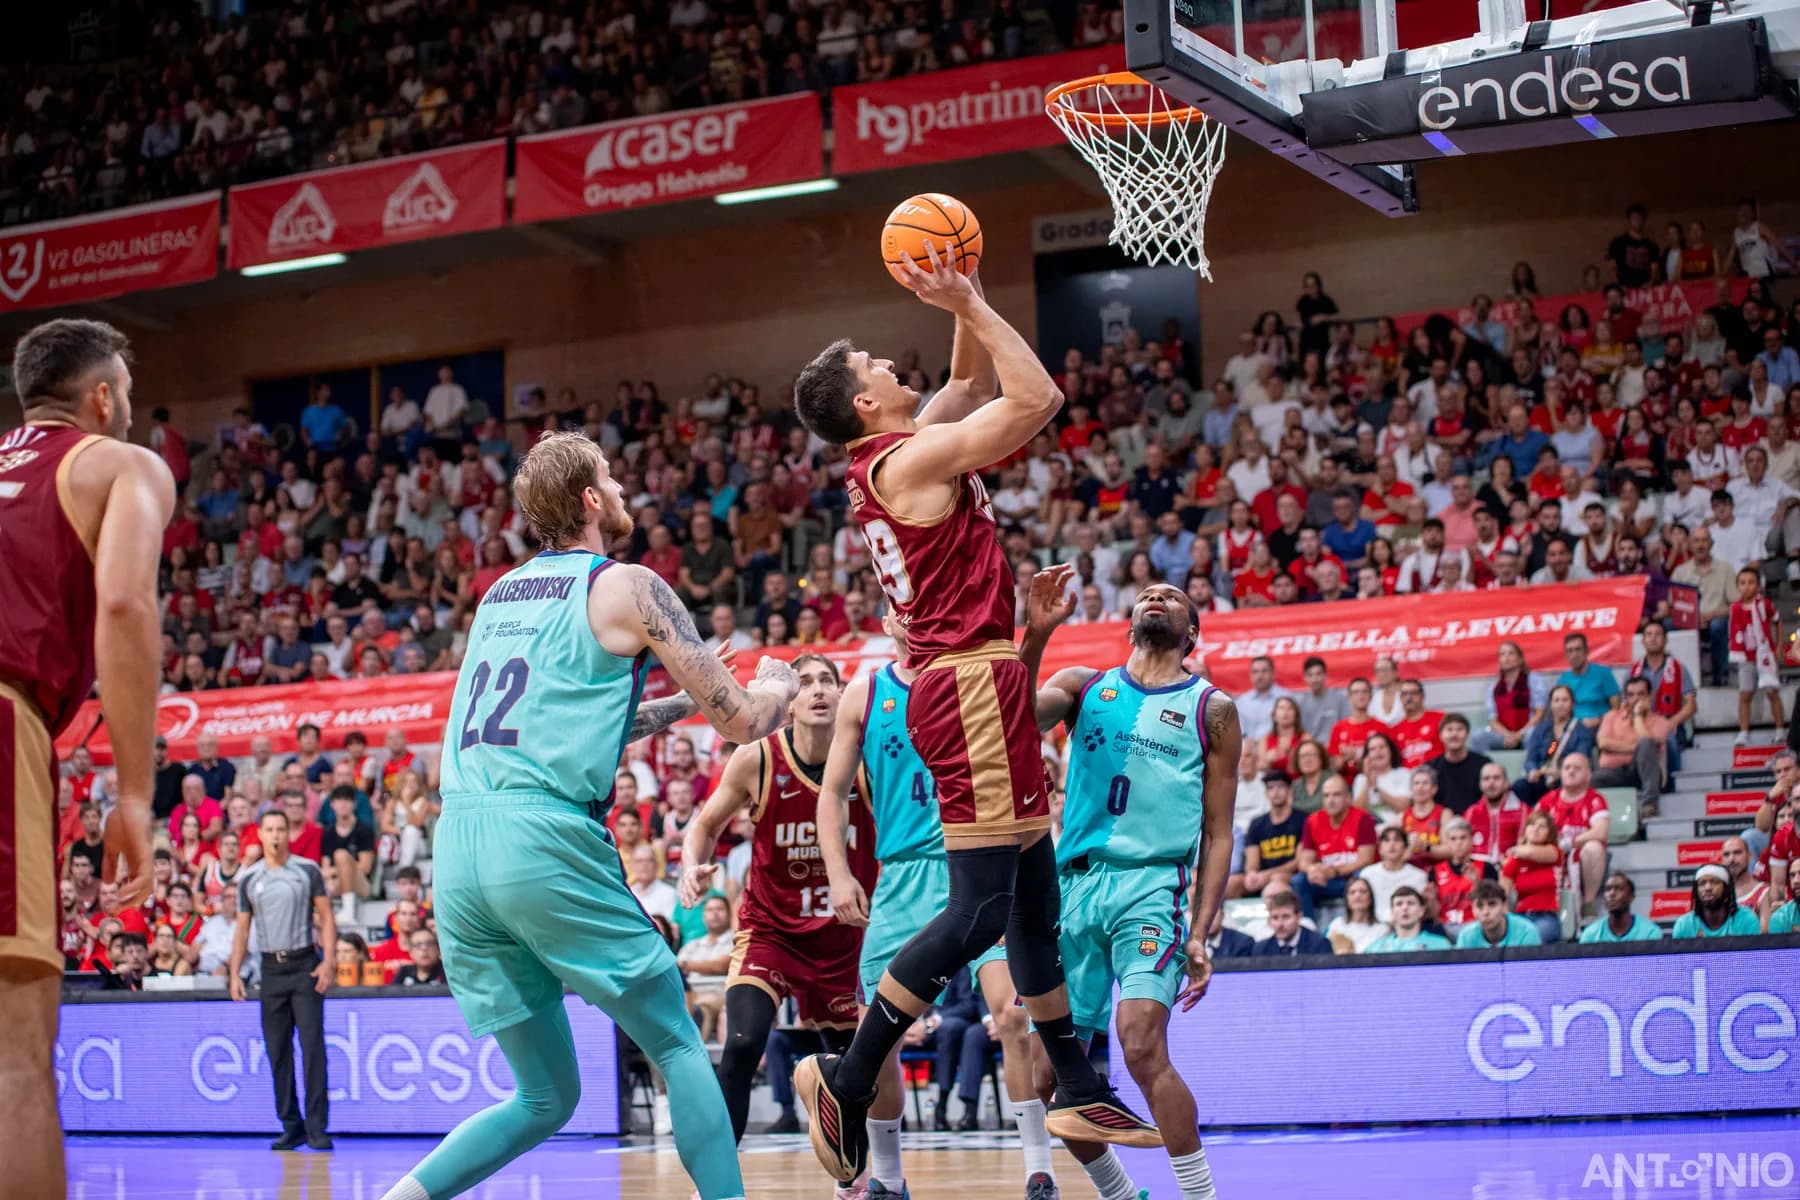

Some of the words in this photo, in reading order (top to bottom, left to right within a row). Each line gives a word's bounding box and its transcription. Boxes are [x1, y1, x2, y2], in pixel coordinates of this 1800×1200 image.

[1418, 55, 1690, 130] endesa
[614, 110, 748, 169] caser
[584, 181, 653, 207] Grupo
[656, 162, 748, 195] Helvetia
[48, 249, 68, 270] V2
[72, 225, 198, 268] GASOLINERAS
[1222, 625, 1411, 660] ESTRELLA
[1441, 607, 1618, 642] LEVANTE
[296, 710, 333, 729] DE
[334, 703, 432, 727] MURCIA
[460, 657, 530, 752] 22
[1115, 731, 1179, 757] Assistència
[911, 772, 938, 808] 4
[1107, 774, 1131, 816] 0
[800, 886, 835, 917] 13
[1466, 968, 1798, 1082] ende
